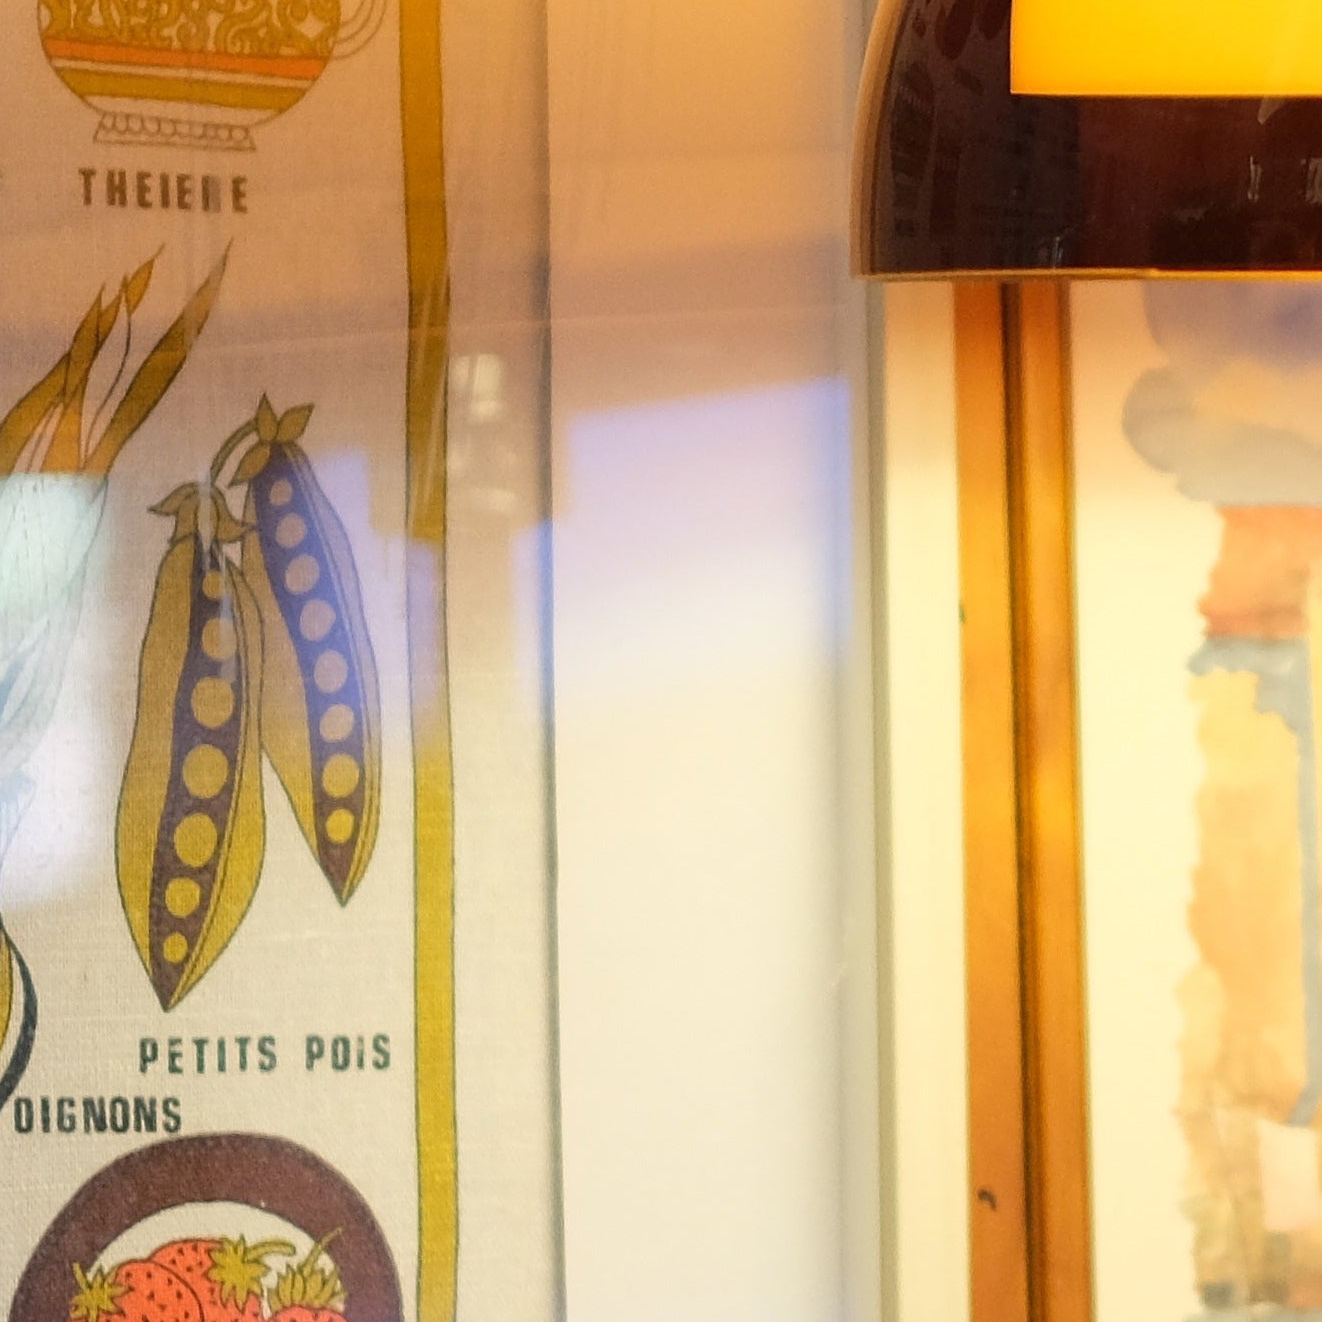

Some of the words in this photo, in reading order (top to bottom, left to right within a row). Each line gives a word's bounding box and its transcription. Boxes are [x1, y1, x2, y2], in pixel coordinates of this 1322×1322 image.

[139, 1034, 278, 1074] PETITS
[305, 1033, 392, 1071] POIS
[13, 1095, 182, 1134] OIGNONS
